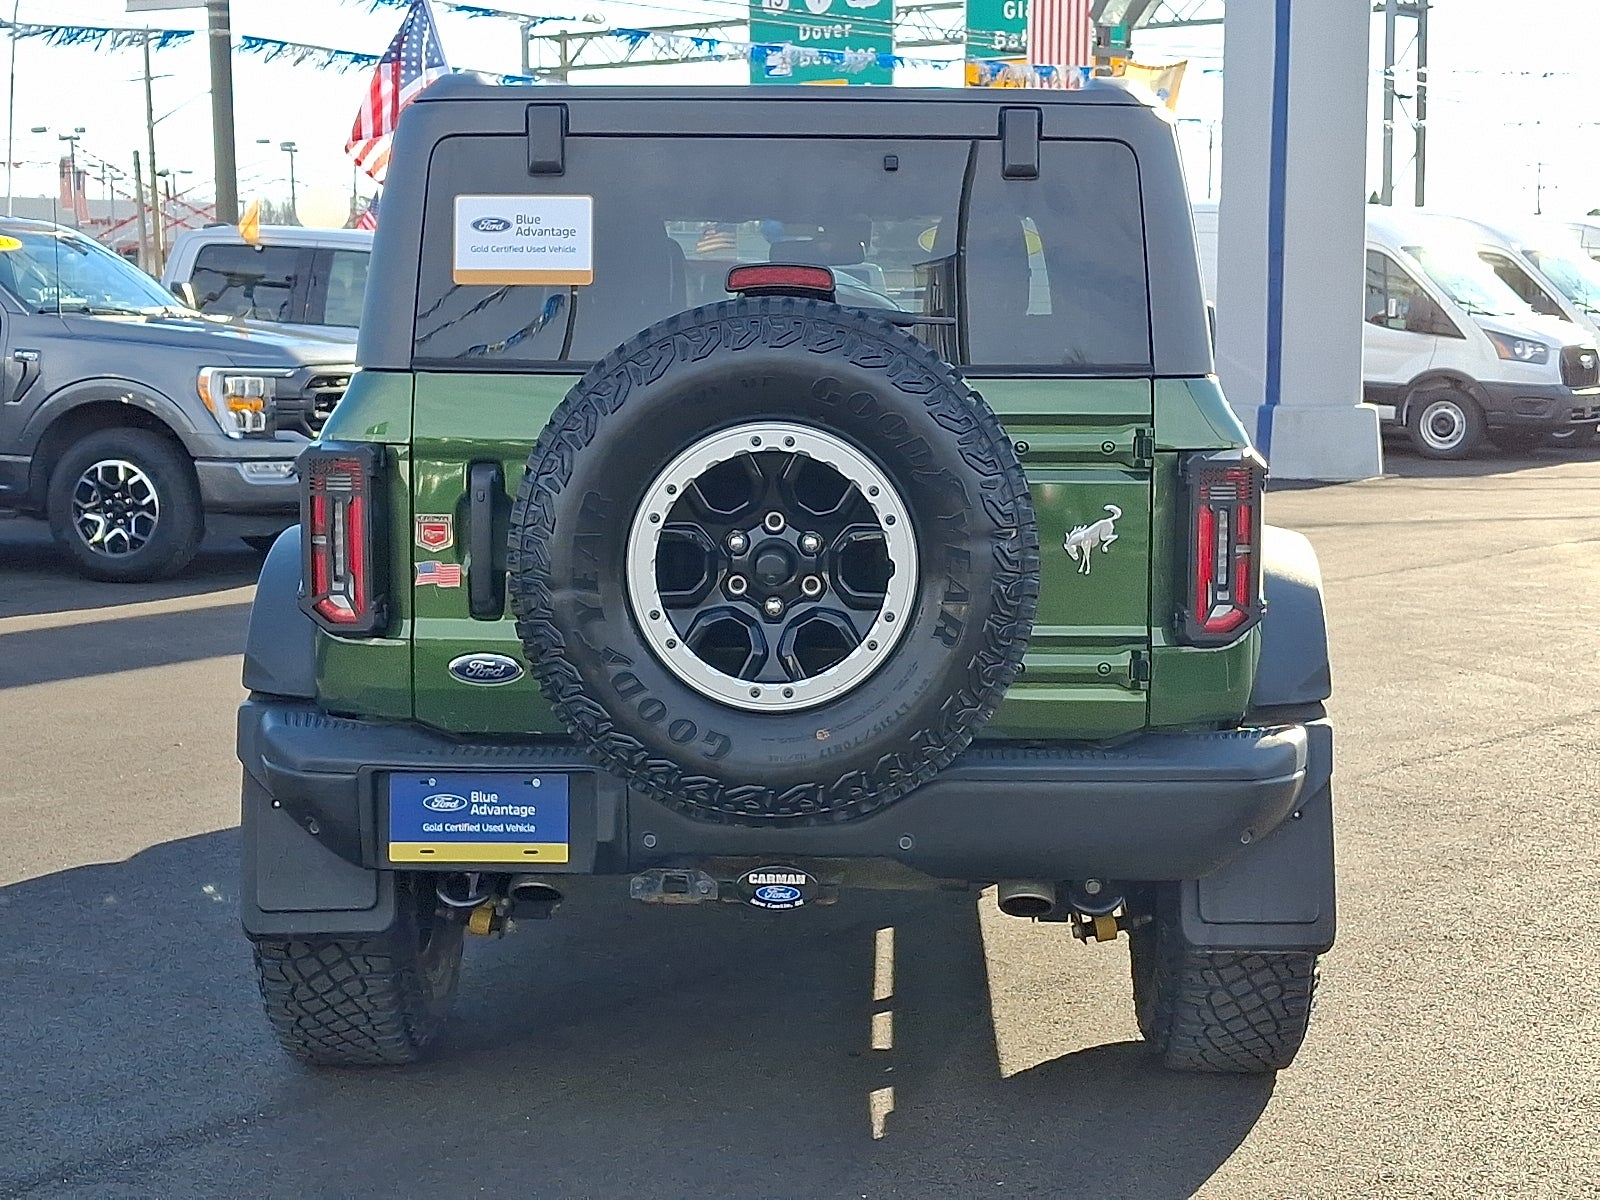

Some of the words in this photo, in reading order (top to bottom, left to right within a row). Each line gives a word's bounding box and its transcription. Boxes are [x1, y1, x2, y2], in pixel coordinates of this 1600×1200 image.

[799, 24, 852, 41] Dover
[477, 218, 506, 232] Ford
[515, 214, 541, 225] Blue
[515, 226, 577, 239] Advantage
[470, 245, 489, 253] Gold
[490, 245, 524, 253] Certified
[526, 245, 547, 253] Used
[549, 245, 577, 253] Vehicle
[465, 659, 505, 678] Ford
[430, 797, 460, 809] Ford
[470, 791, 498, 803] Blue
[470, 803, 536, 817] Advantage
[422, 822, 443, 832] Gold
[444, 822, 480, 833] Certified
[481, 822, 504, 832] Used
[505, 822, 536, 833] Vehicle
[748, 873, 806, 885] CARMAN
[763, 886, 793, 899] Ford
